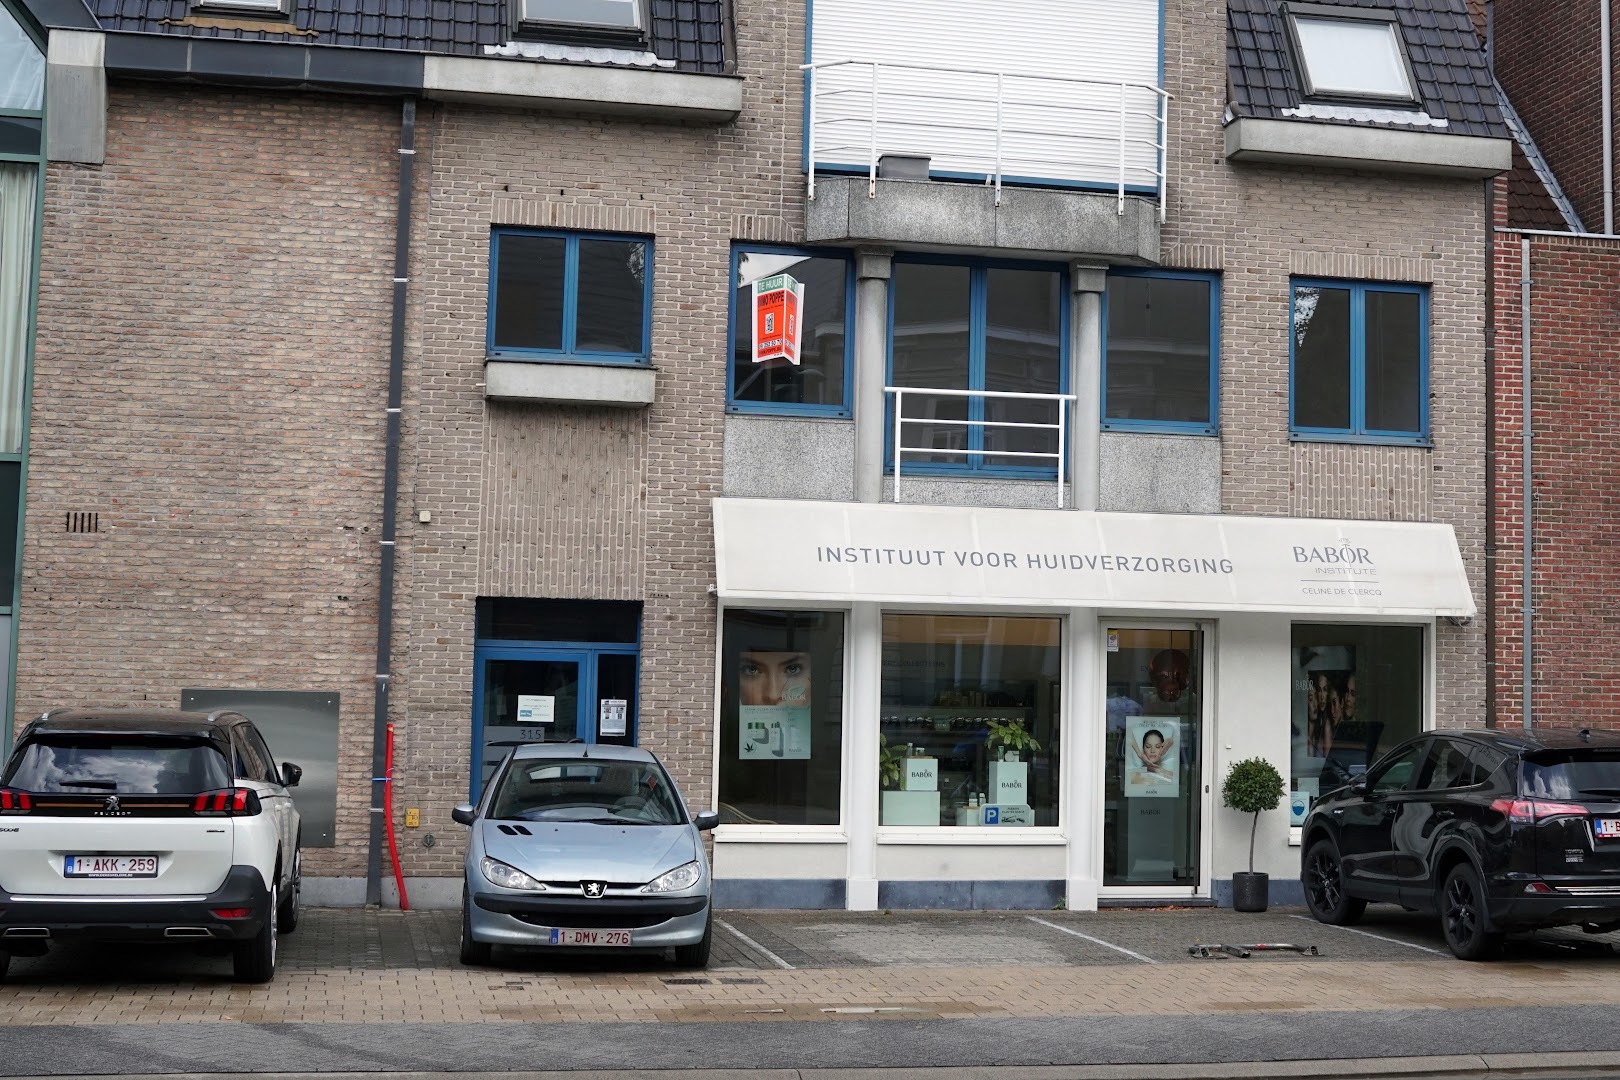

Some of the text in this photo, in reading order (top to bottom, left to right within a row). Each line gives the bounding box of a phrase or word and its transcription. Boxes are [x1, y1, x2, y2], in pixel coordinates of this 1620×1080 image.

[758, 281, 765, 292] TE
[766, 277, 783, 290] HUUR
[769, 291, 785, 304] POPPE
[817, 547, 1234, 574] INSTITUUT VOOR HUIDVERZORGING
[1292, 544, 1374, 566] BABOR
[1314, 567, 1377, 575] INSTITUTE
[1302, 587, 1332, 595] CELINE
[1347, 588, 1382, 596] CLERCQ
[1295, 677, 1314, 691] BABOR
[519, 729, 542, 740] 315
[911, 769, 933, 778] BABOR
[1001, 780, 1023, 789] BABOR
[986, 809, 997, 823] P
